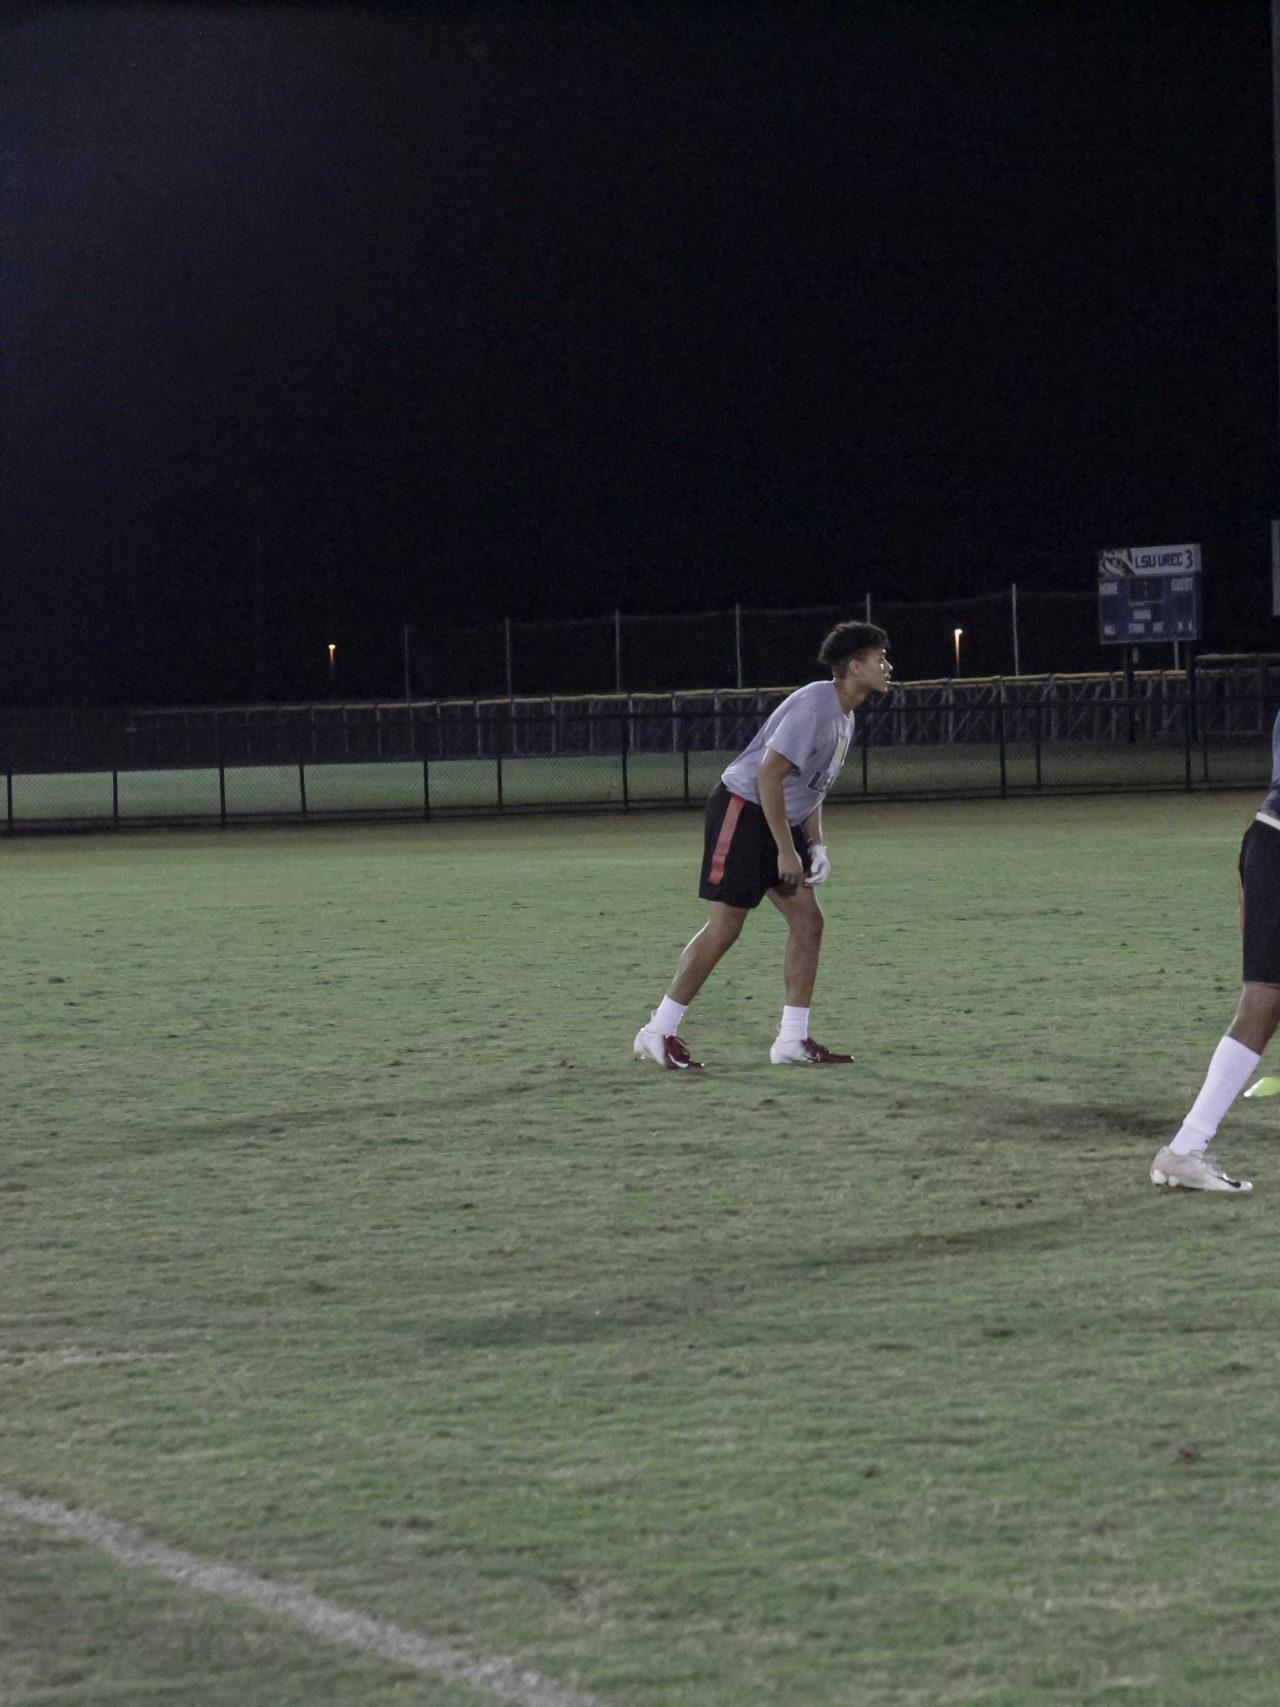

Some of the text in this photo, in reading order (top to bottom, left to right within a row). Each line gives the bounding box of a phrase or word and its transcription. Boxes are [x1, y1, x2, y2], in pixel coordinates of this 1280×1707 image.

[1134, 549, 1193, 570] LSU UREC 3
